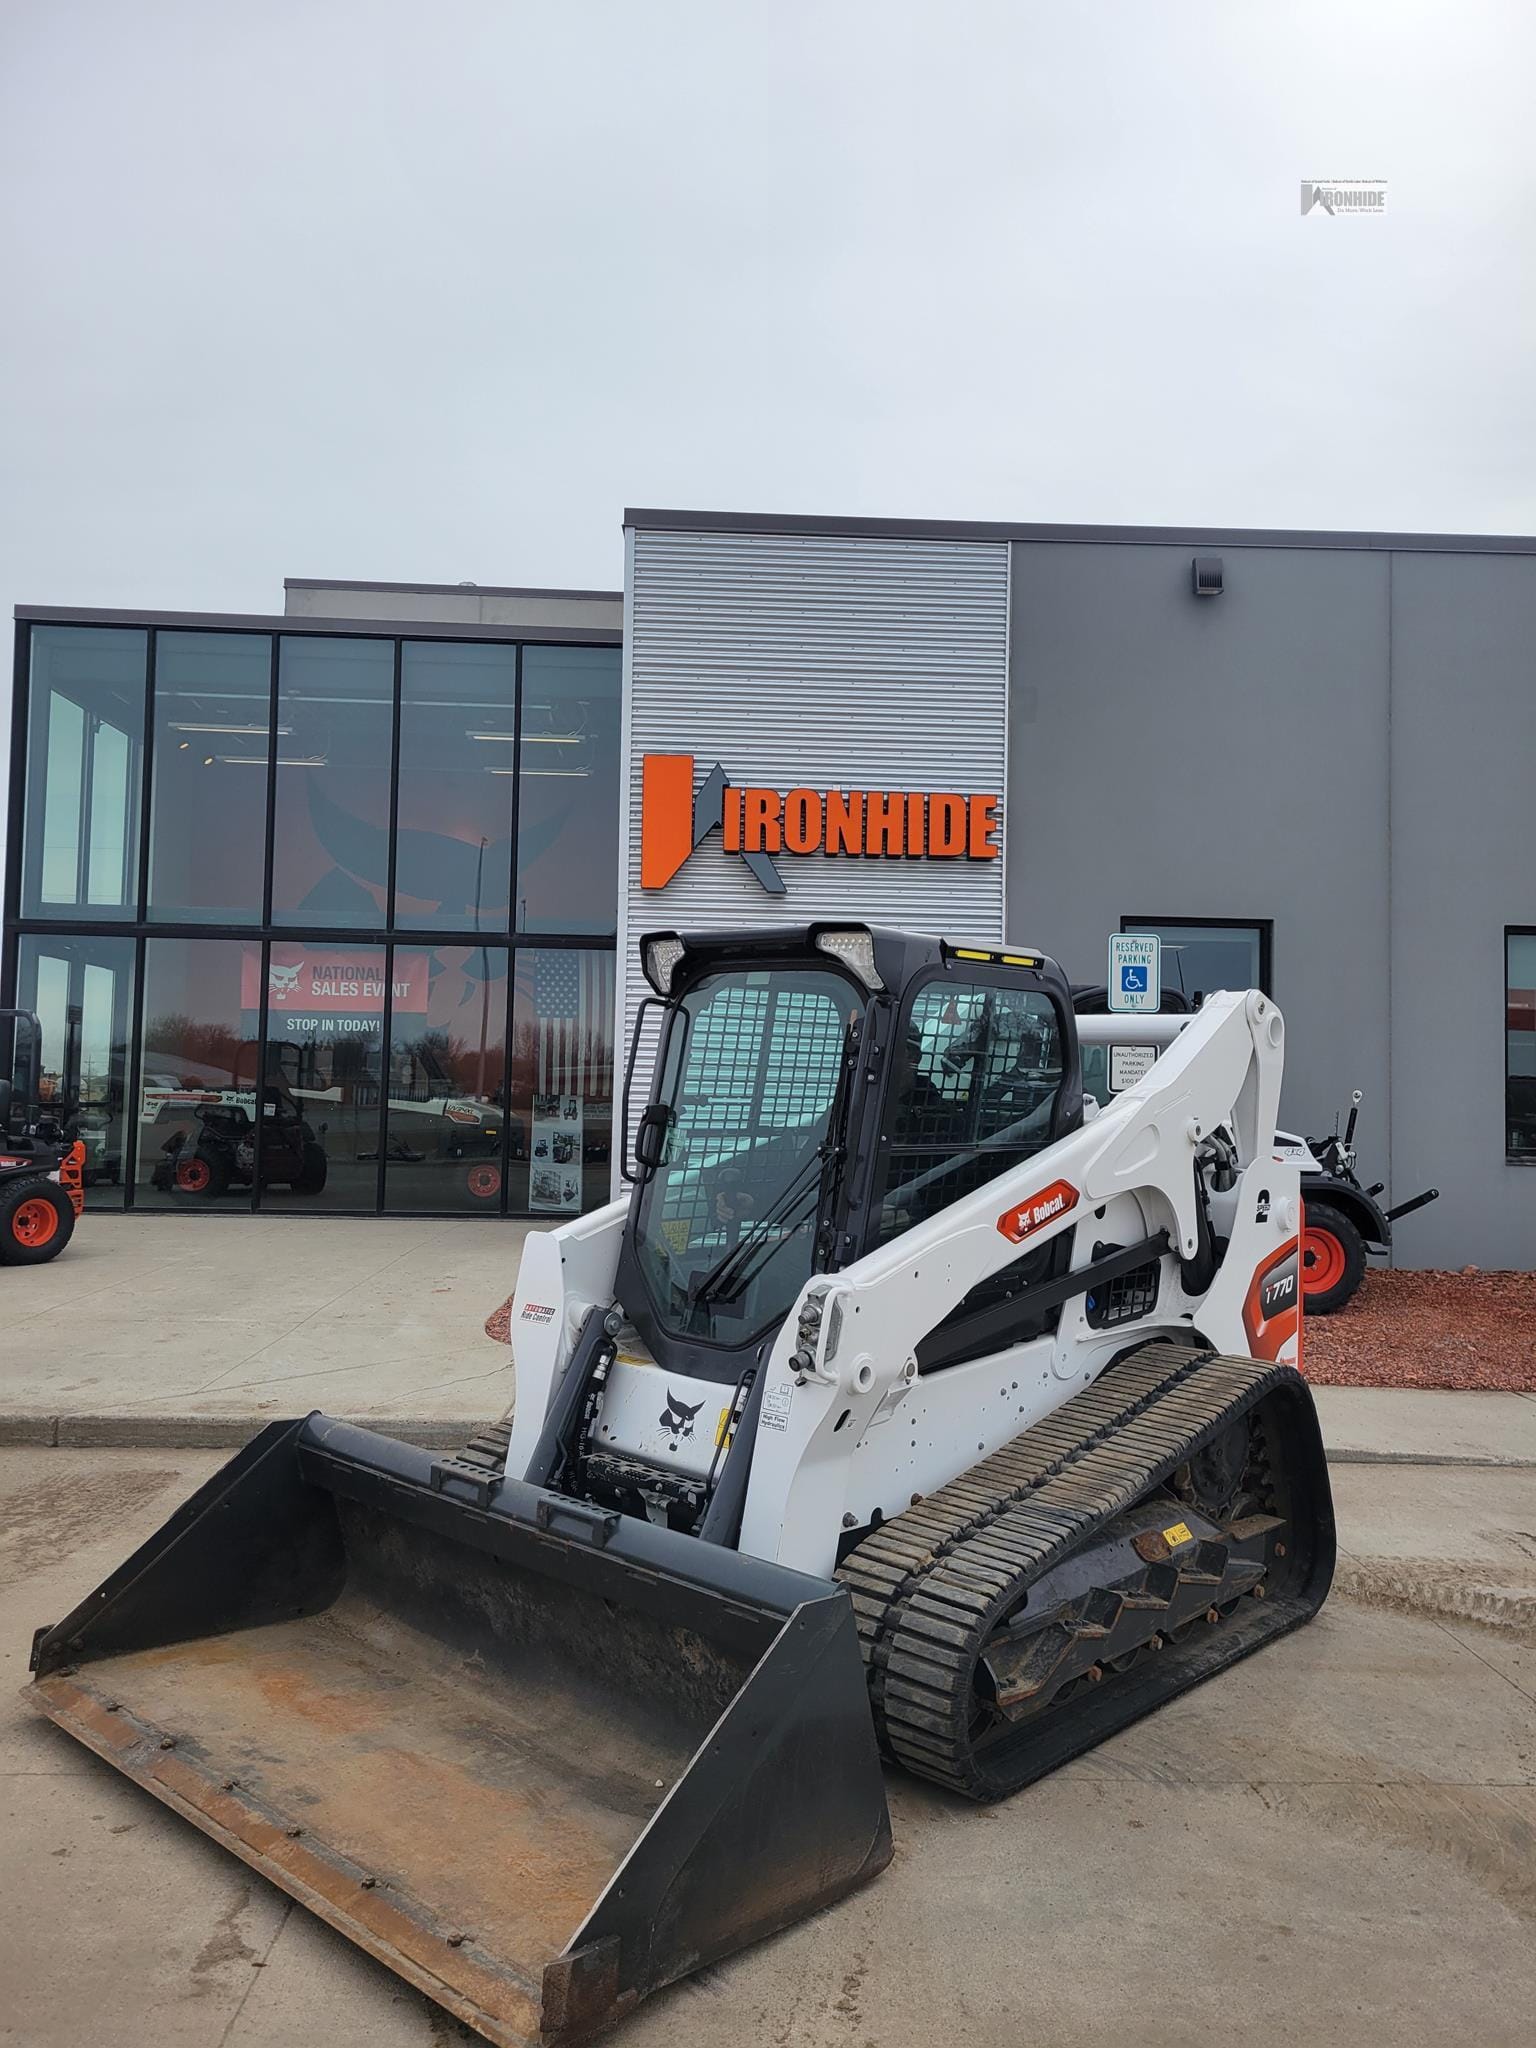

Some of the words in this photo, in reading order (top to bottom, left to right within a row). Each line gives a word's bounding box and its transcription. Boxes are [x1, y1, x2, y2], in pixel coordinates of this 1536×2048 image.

[723, 788, 998, 858] IRONHIDE
[1116, 942, 1154, 952] RESERVED
[1118, 954, 1152, 964] PARKING
[313, 966, 384, 981] NATIONAL
[312, 981, 358, 996] SALES
[363, 983, 410, 997] EVNT
[1124, 994, 1145, 1004] ONLY
[287, 1018, 318, 1030] STOP
[322, 1019, 334, 1031] IN
[337, 1020, 380, 1032] TODAY!
[236, 1097, 256, 1105] Bobca
[1033, 1193, 1064, 1224] Bobcat
[1266, 1274, 1294, 1304] T770
[532, 1312, 553, 1323] Control
